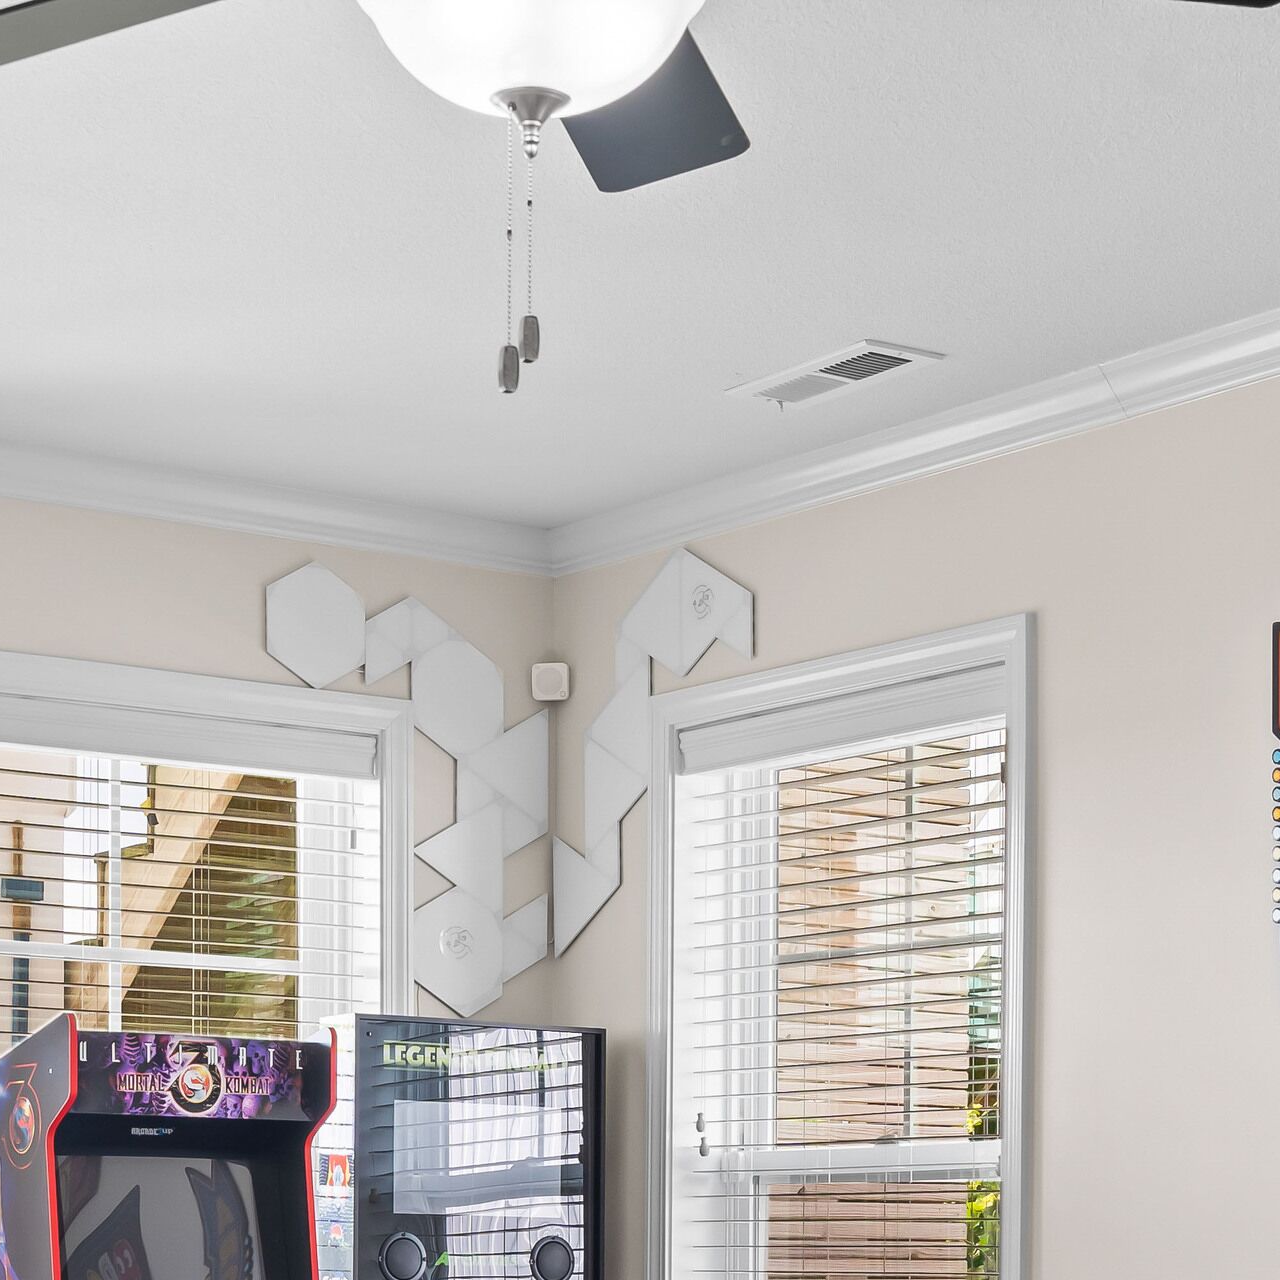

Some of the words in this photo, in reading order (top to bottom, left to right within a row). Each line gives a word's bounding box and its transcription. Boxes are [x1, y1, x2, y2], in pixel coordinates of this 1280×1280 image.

[79, 1041, 303, 1070] ULTIMATE
[117, 1072, 166, 1092] MORTAL
[223, 1076, 273, 1096] KOMBAT
